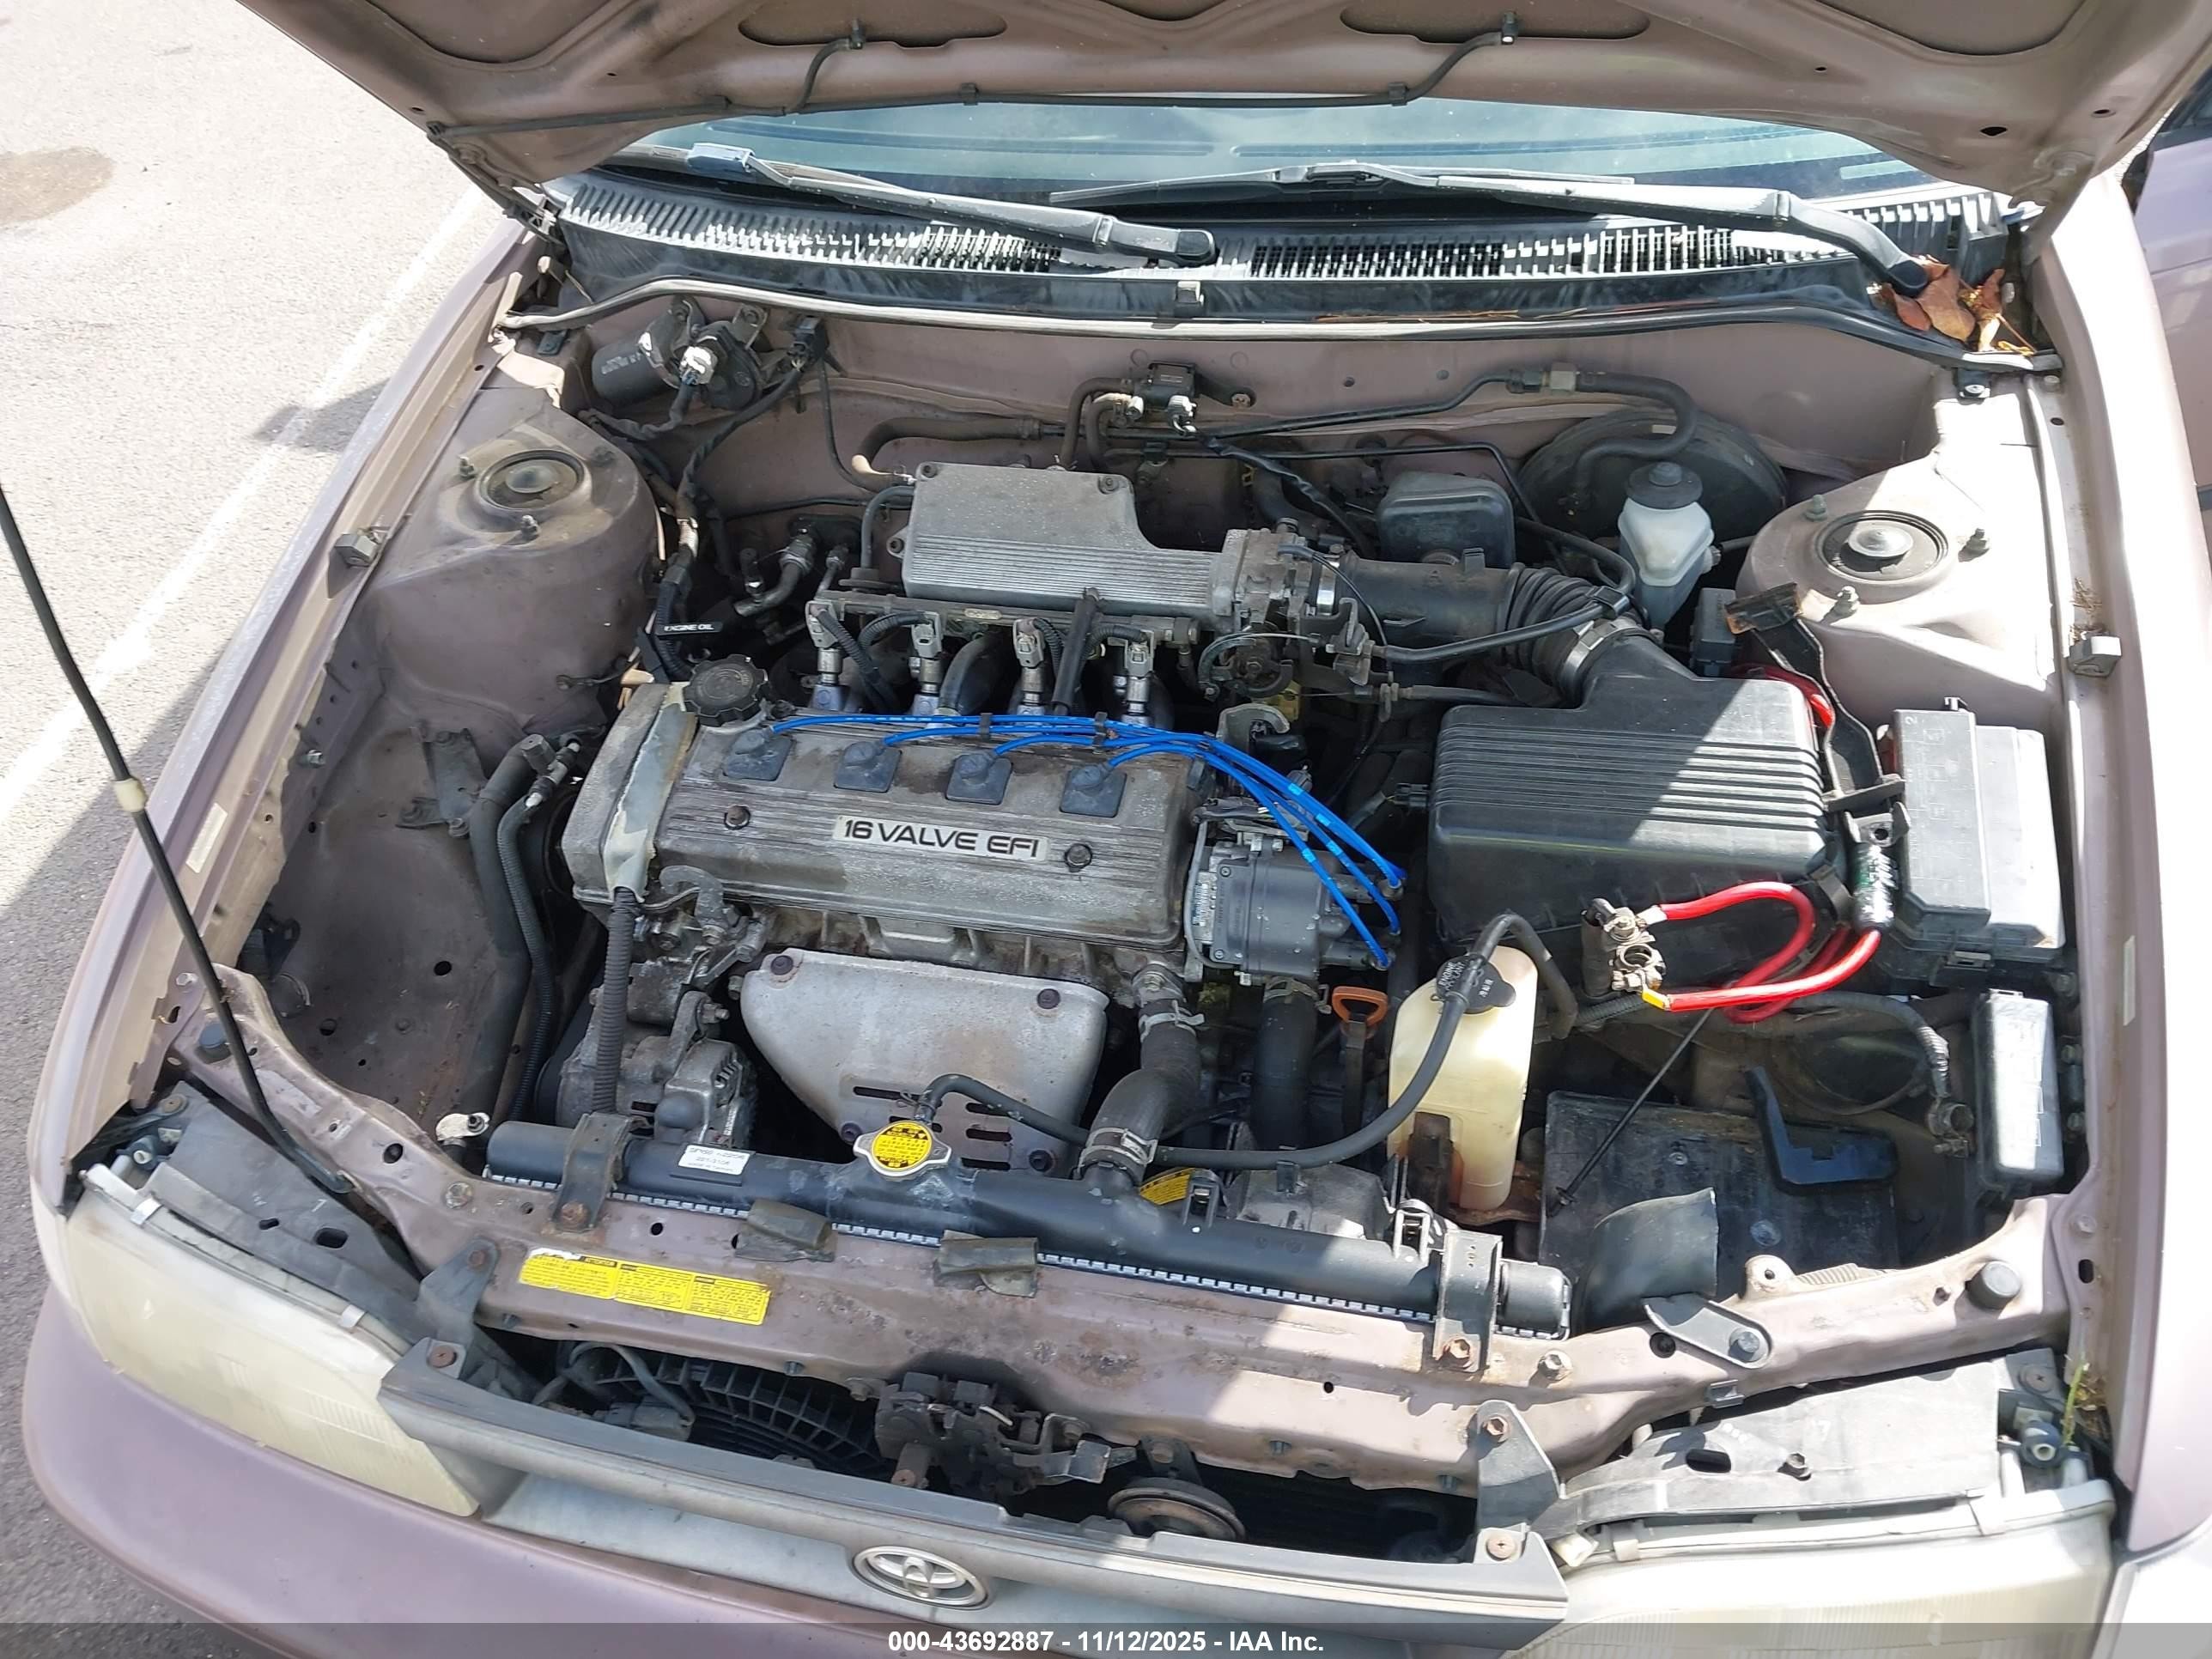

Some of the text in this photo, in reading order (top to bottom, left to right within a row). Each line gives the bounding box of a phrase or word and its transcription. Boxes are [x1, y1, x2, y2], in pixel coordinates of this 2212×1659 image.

[844, 819, 1039, 858] 16 VALVE EFI
